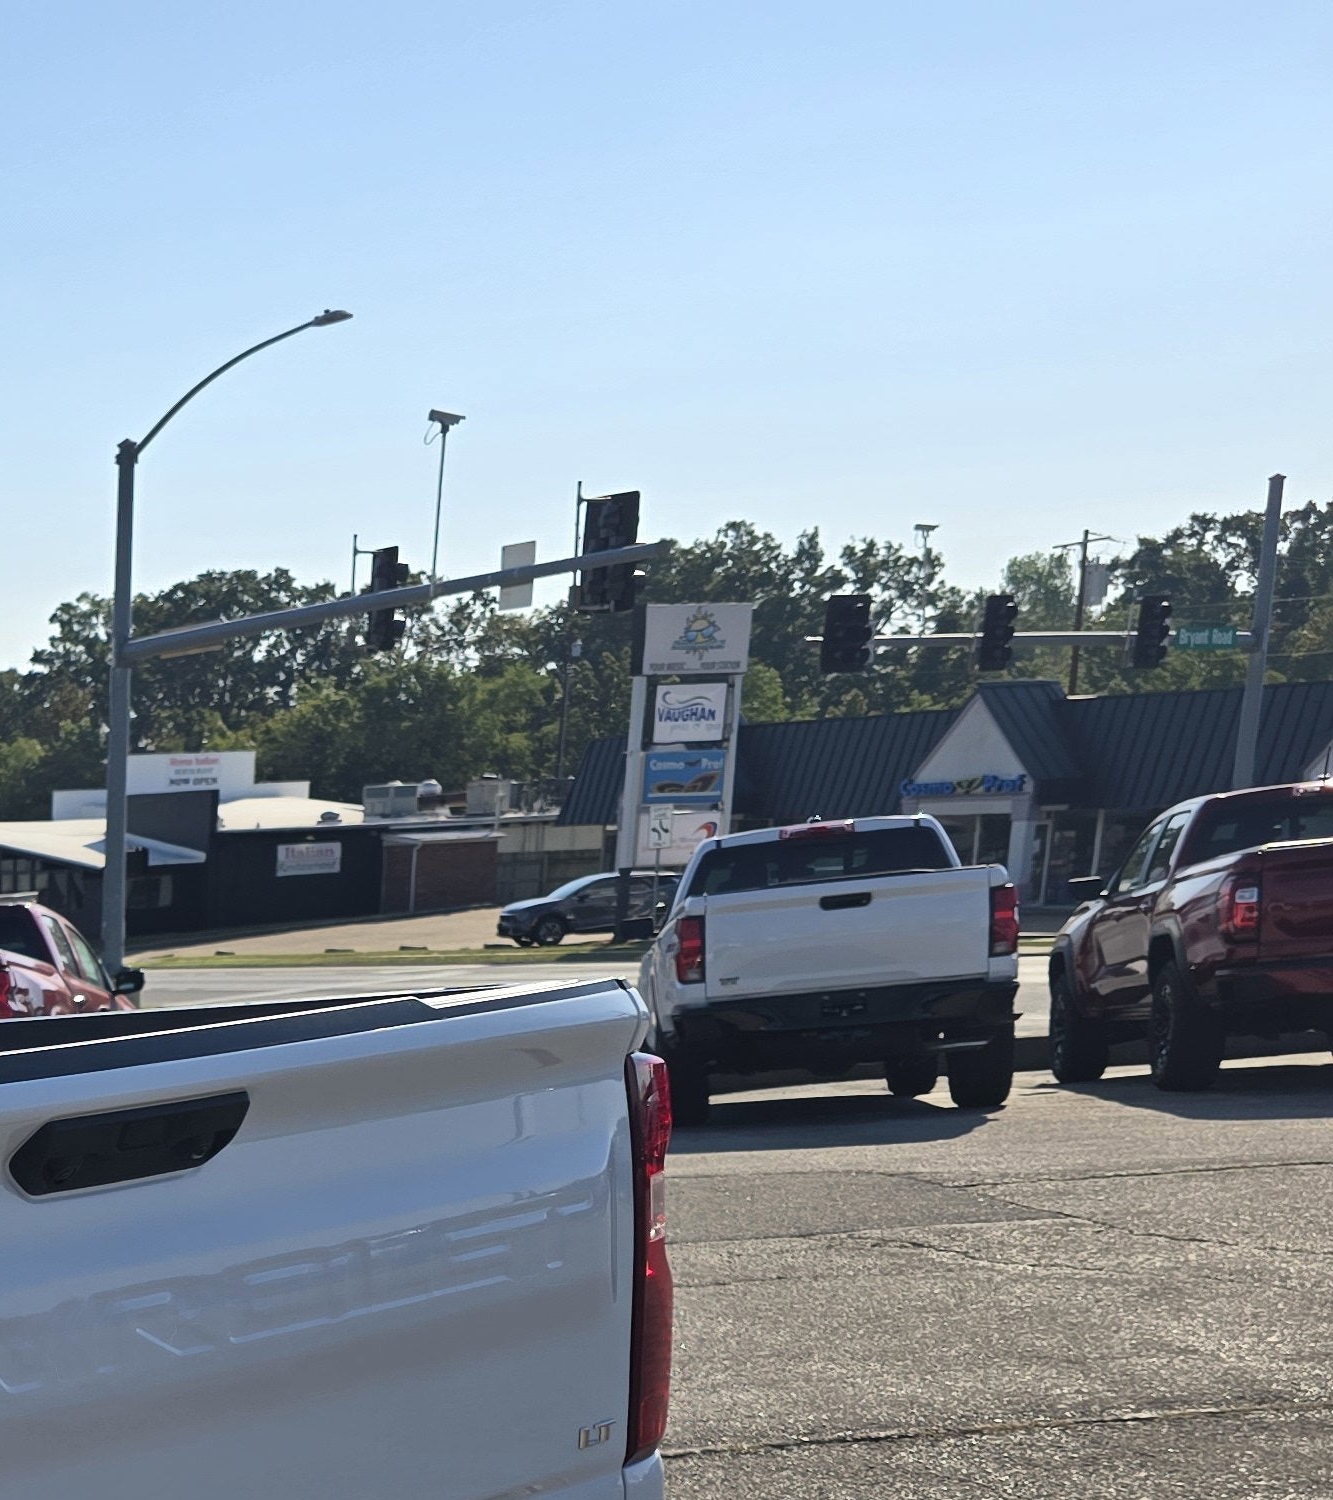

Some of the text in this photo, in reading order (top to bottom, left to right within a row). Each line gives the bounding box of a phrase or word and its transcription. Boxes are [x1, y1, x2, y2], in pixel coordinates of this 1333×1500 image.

[1179, 628, 1233, 648] Bryant Road
[658, 707, 716, 722] VAUGHAN
[649, 760, 686, 771] Cosmo
[192, 777, 218, 786] OPEN
[900, 774, 1026, 796] Cosmo Prof
[284, 846, 334, 859] Italian
[578, 1418, 616, 1449] LT
